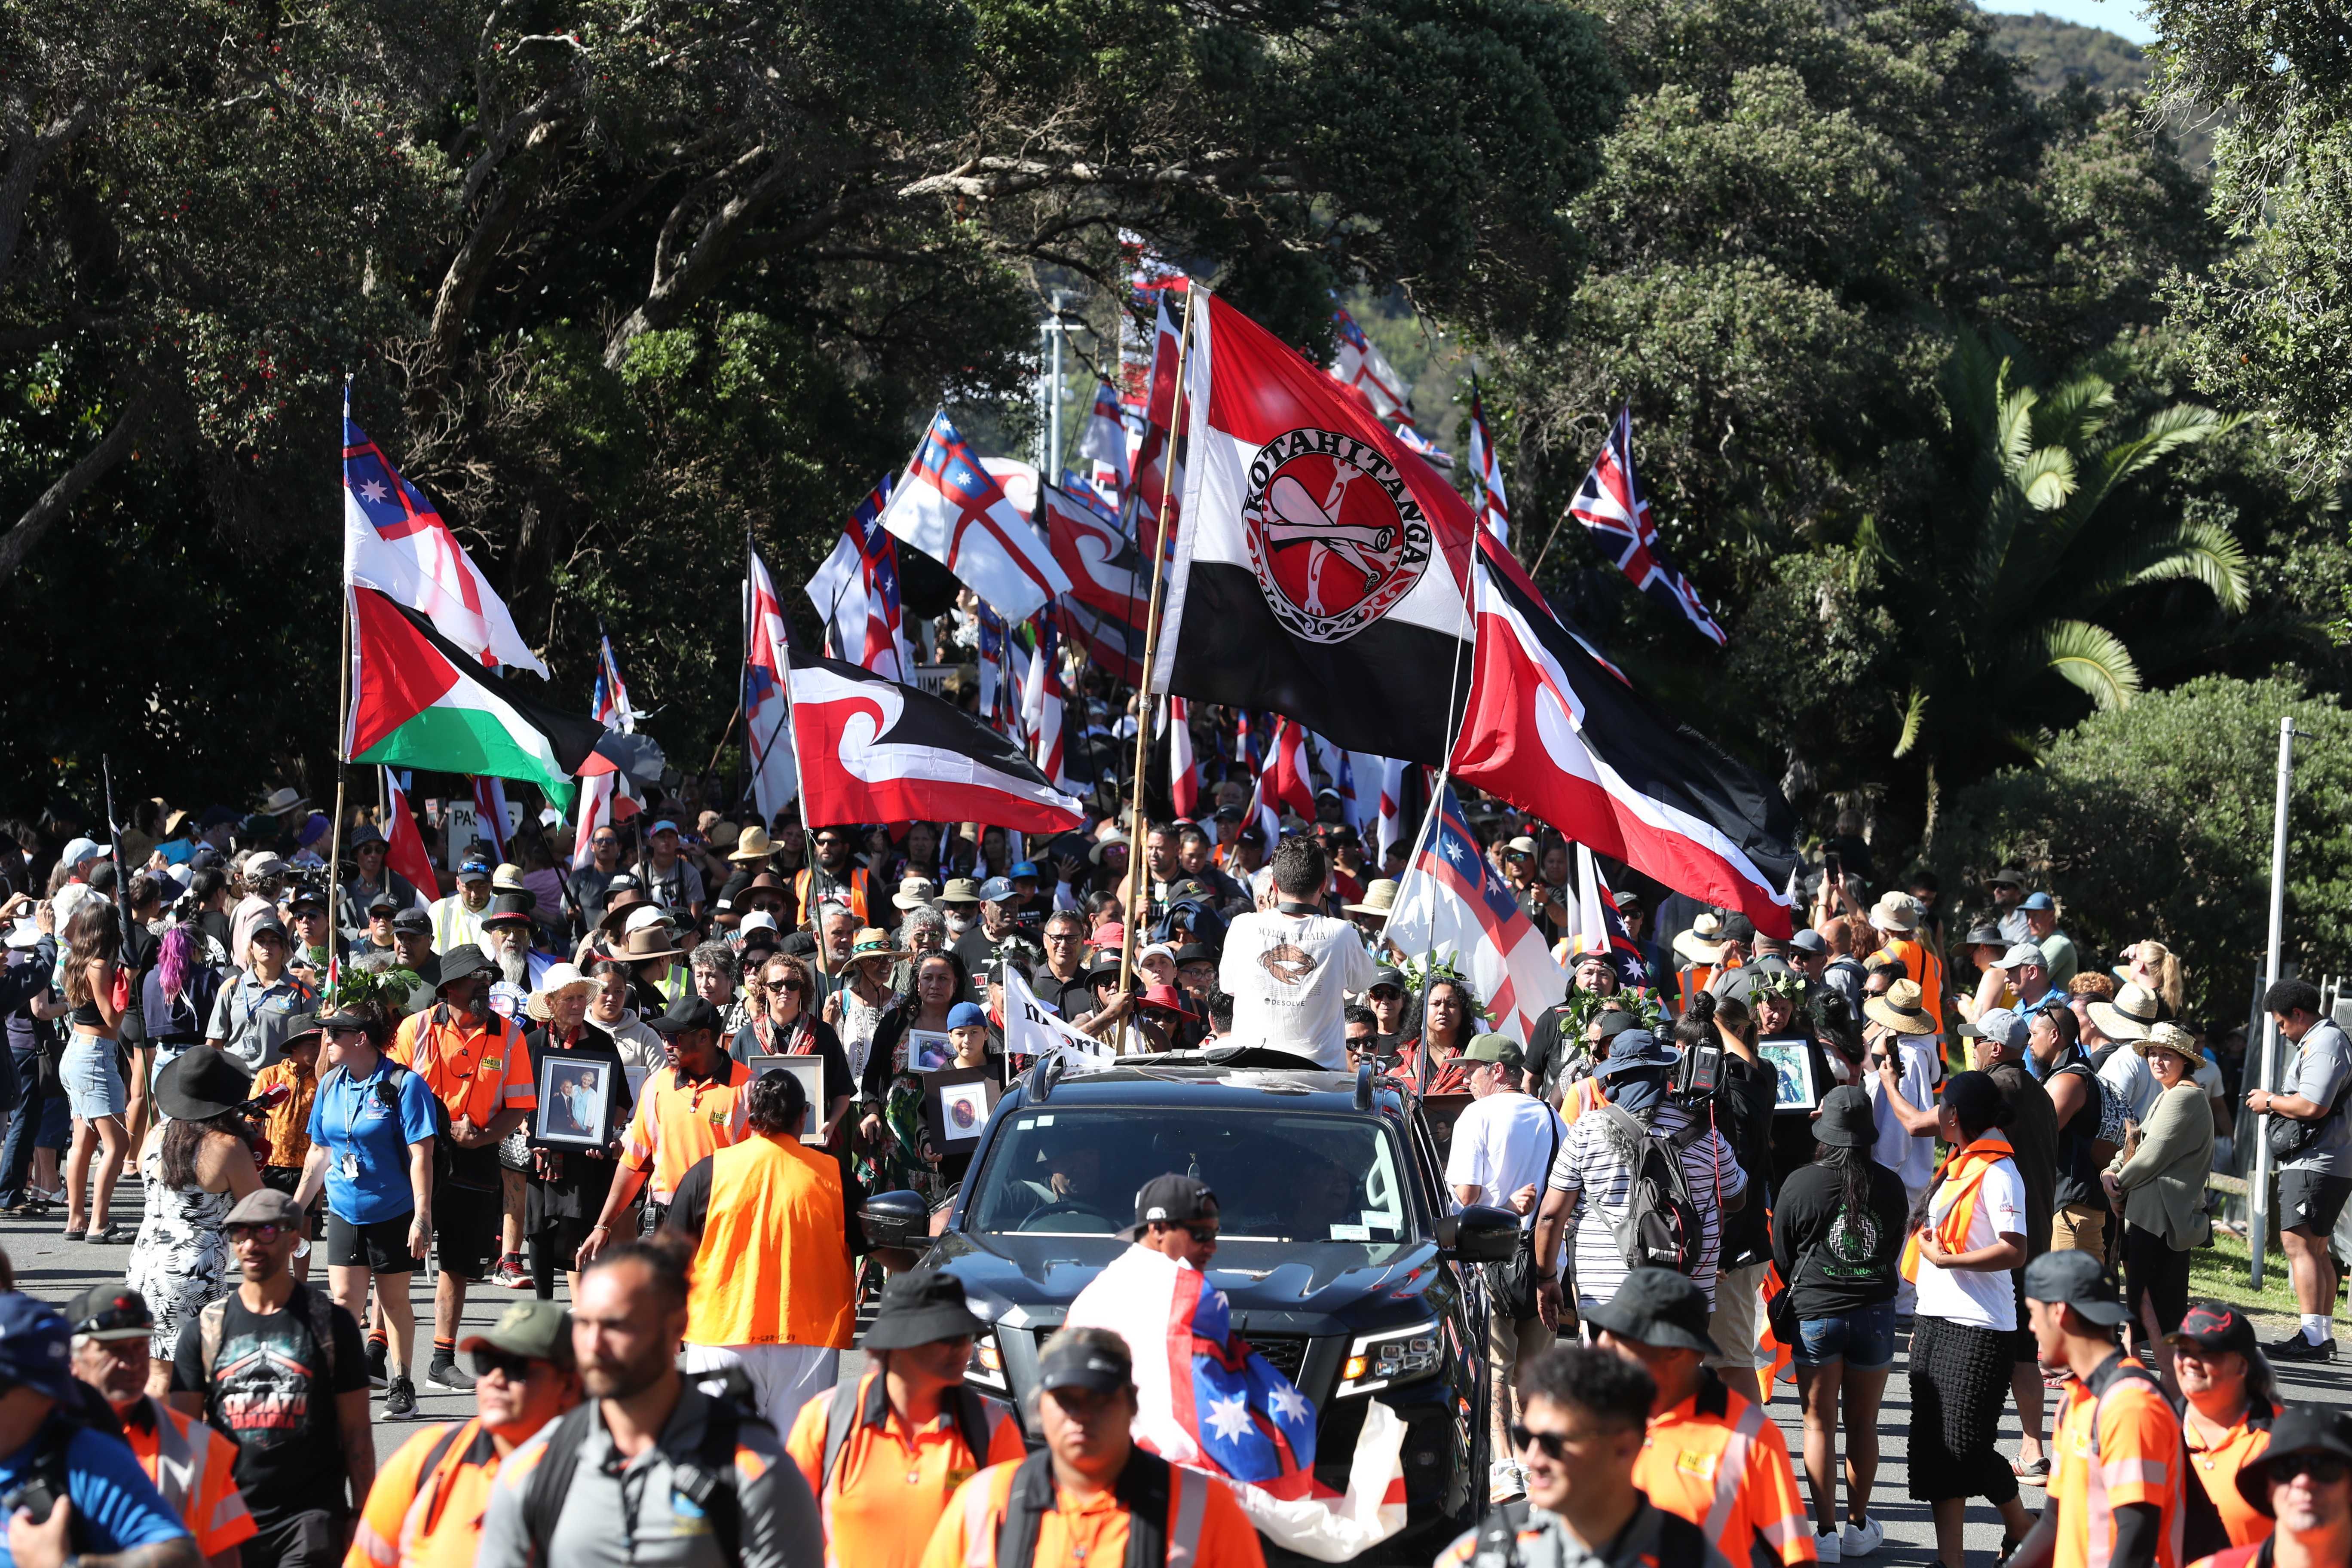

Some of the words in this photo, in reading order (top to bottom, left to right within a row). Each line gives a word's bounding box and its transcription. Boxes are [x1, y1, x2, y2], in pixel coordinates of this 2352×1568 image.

[1246, 430, 1427, 566] KOTAHITANGA
[1259, 927, 1286, 940] SCYLLA
[1290, 931, 1326, 941] SERRATA
[713, 1112, 723, 1120] TBC
[1870, 1210, 1883, 1231] MĀORI
